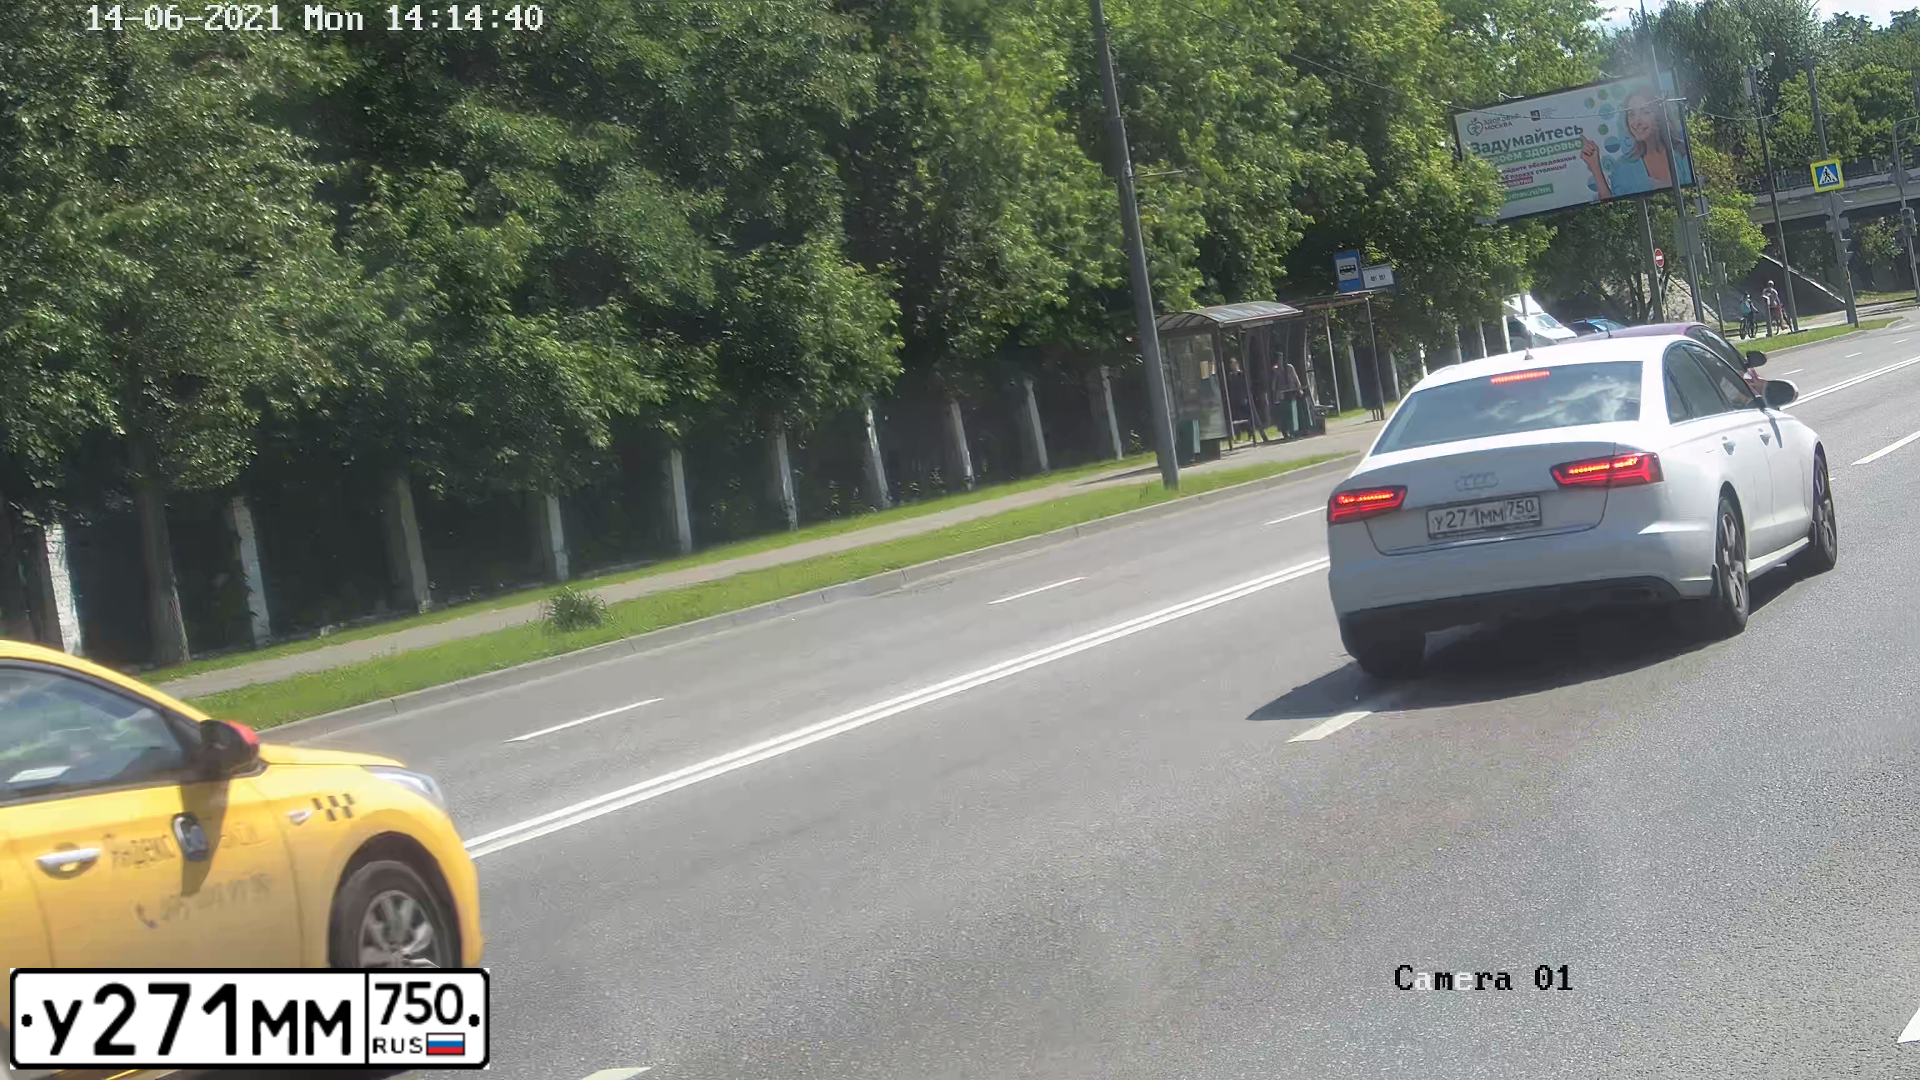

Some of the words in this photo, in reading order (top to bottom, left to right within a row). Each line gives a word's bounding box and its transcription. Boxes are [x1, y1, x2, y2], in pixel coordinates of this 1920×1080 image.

[1471, 124, 1584, 156] Задумайтесь
[1525, 139, 1583, 158] здоровье
[1528, 155, 1577, 169] обследование
[1506, 499, 1535, 518] 750
